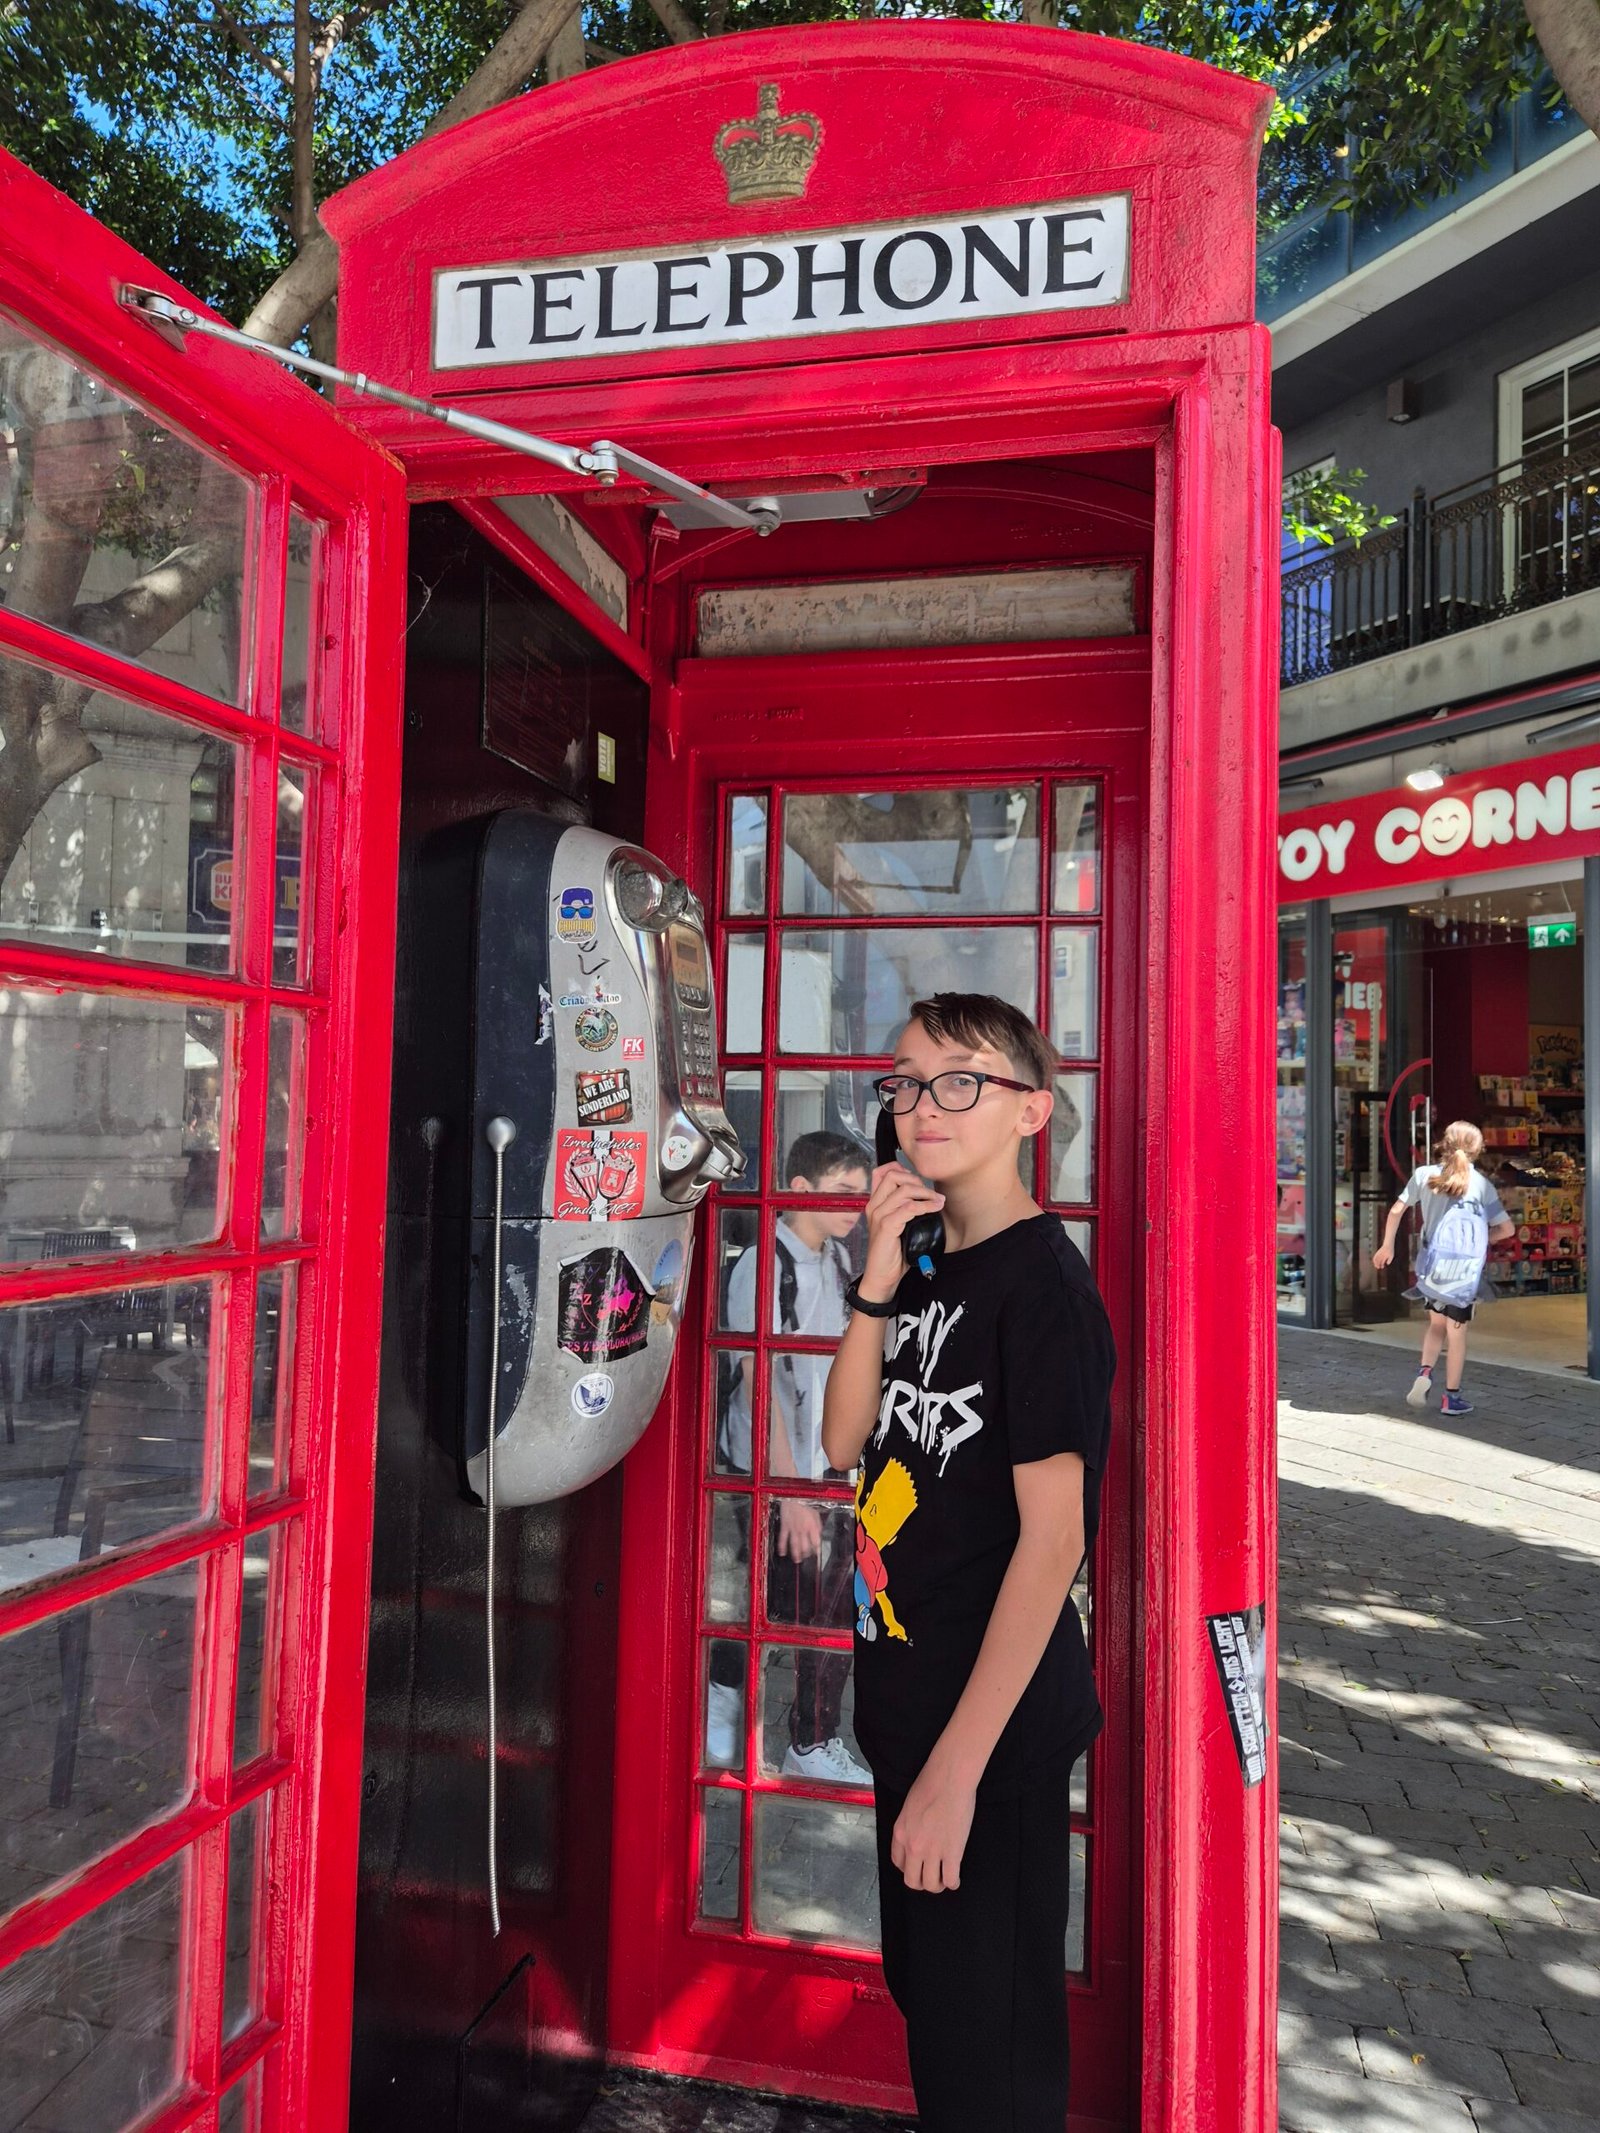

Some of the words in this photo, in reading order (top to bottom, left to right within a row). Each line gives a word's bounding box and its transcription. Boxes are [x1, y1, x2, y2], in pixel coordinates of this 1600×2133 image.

[456, 209, 1106, 350] TELEPHONE
[1278, 819, 1355, 881] OY
[1375, 766, 1600, 864] CORNE
[623, 1038, 643, 1052] FK
[583, 1084, 598, 1098] WE
[598, 1077, 616, 1094] ARE
[578, 1088, 630, 1117] SUNDERLAND
[1433, 1258, 1480, 1280] NIKE
[870, 1379, 984, 1477] RTS
